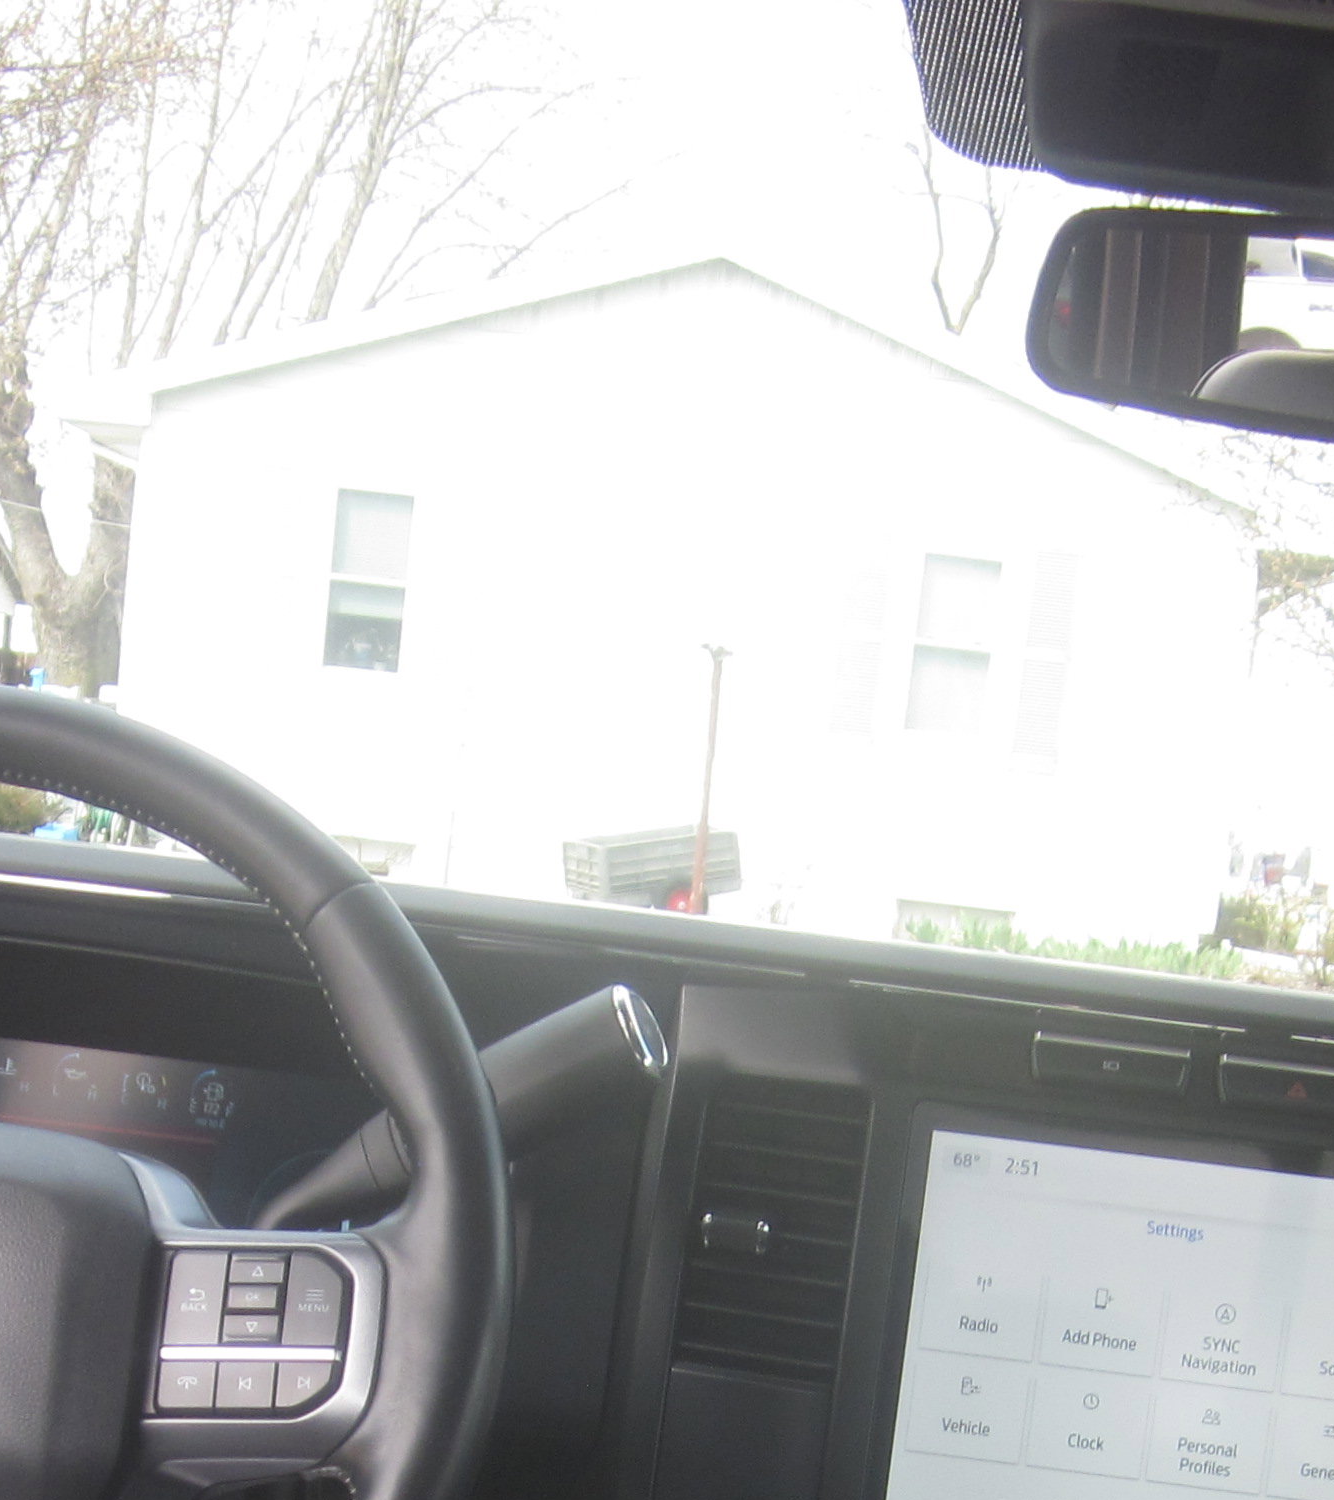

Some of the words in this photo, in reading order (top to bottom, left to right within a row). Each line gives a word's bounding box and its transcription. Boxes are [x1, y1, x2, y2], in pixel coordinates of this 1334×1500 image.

[1004, 1157, 1040, 1177] 2:51
[1146, 1220, 1205, 1243] Settings
[180, 1303, 209, 1313] BACK
[298, 1303, 330, 1313] MENU
[958, 1315, 999, 1334] Radio
[1061, 1328, 1089, 1346] Add
[1091, 1332, 1138, 1353] Phone
[1202, 1336, 1241, 1354] SYNC
[1180, 1354, 1257, 1377] Navigation
[941, 1417, 991, 1437] Vehicle
[1067, 1432, 1104, 1451] Clock
[1176, 1437, 1238, 1459] Personal
[1178, 1457, 1231, 1478] Profiles
